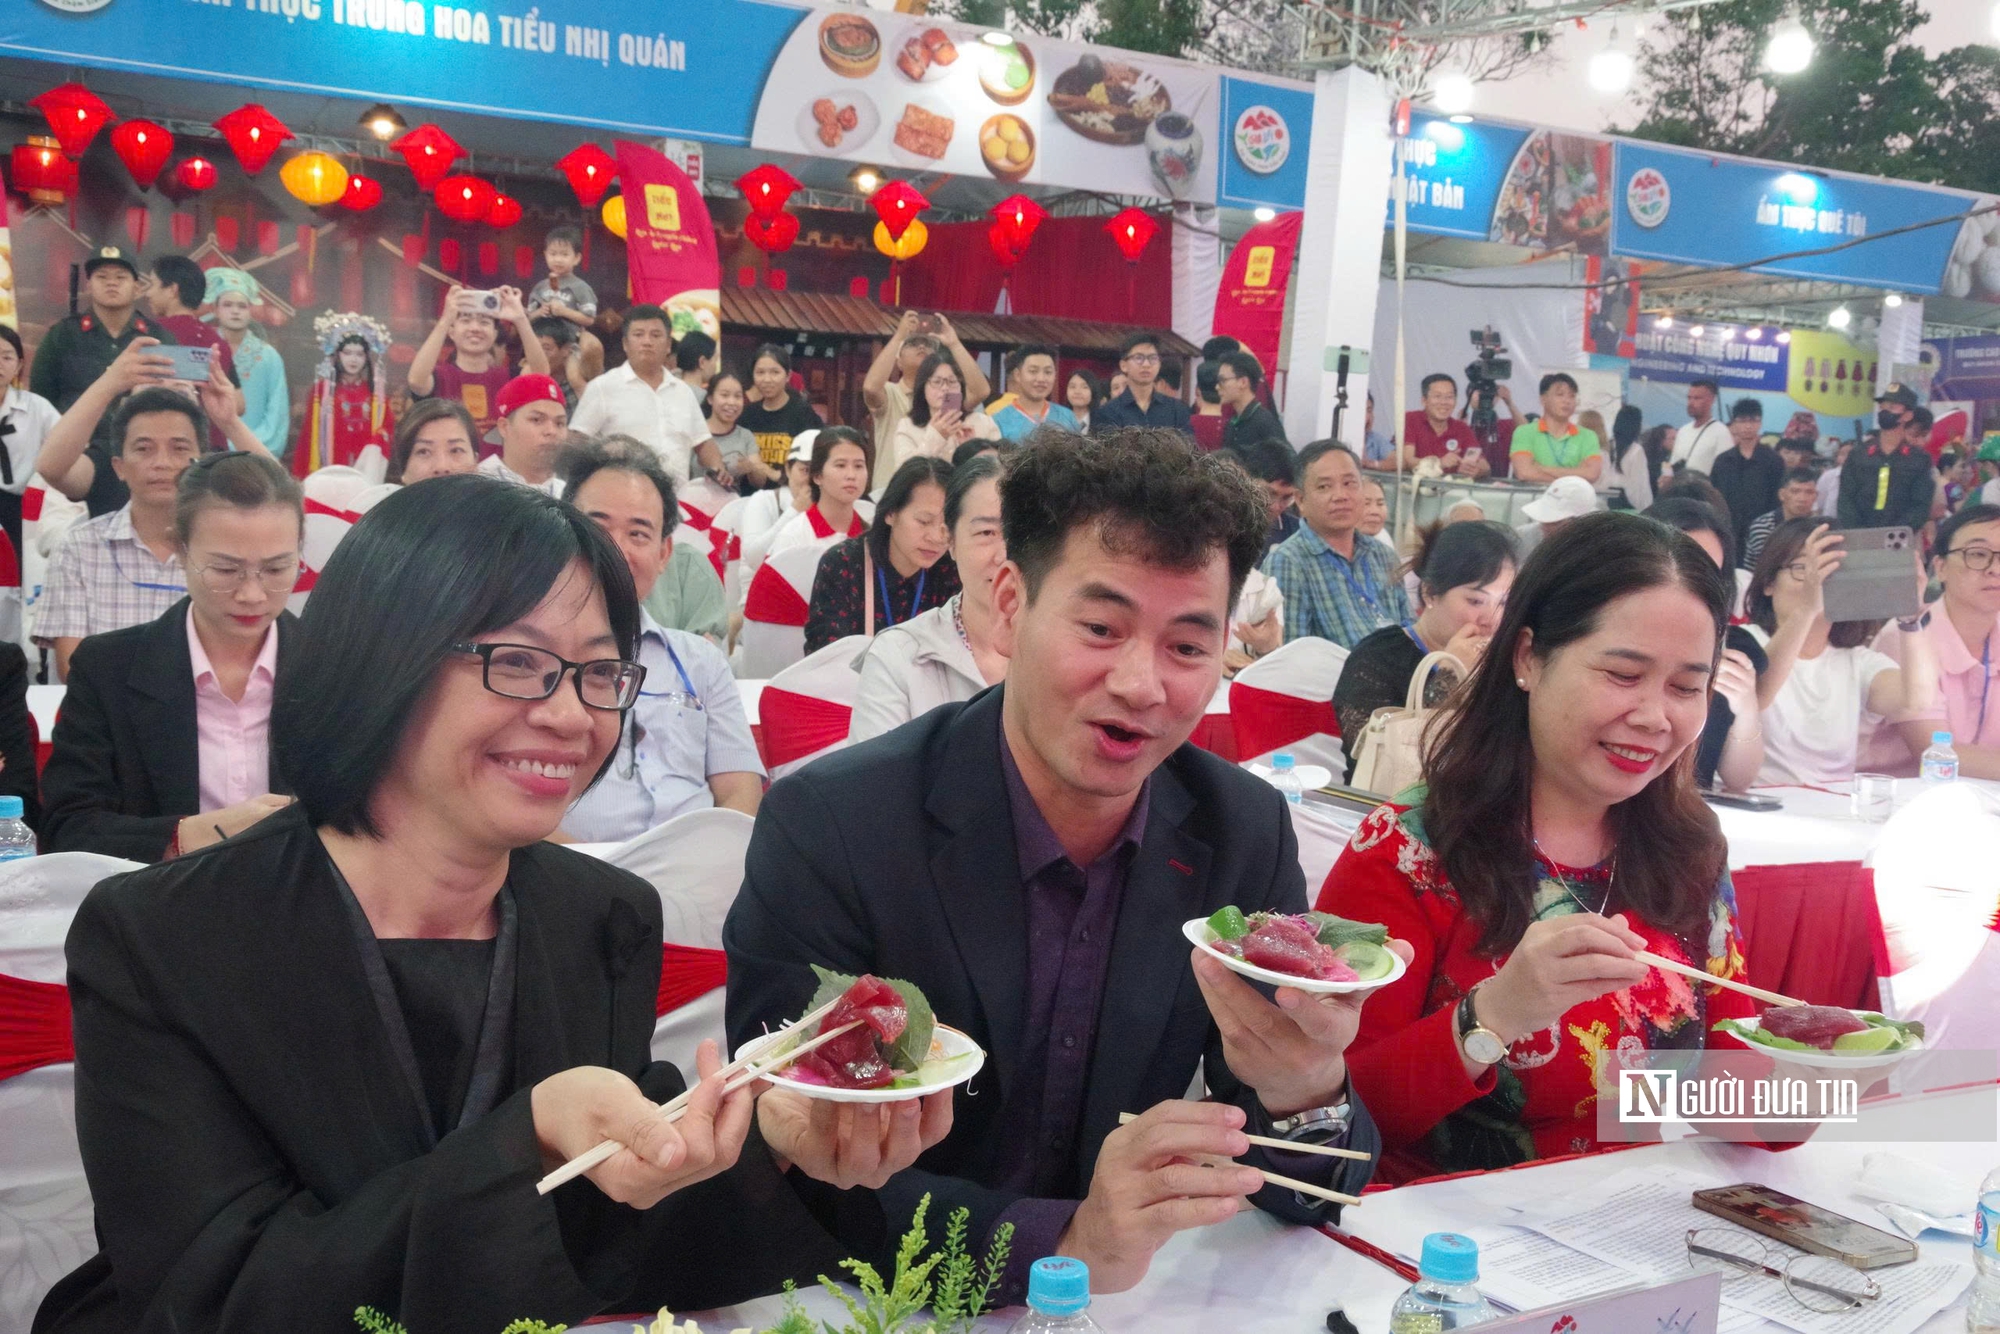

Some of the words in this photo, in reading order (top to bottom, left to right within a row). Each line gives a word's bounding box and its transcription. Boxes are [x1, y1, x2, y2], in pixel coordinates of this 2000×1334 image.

[333, 0, 425, 36] TRUNG
[434, 5, 490, 44] HOA
[498, 7, 555, 53] TIỂU
[564, 25, 609, 67] NHỊ
[618, 33, 686, 71] QUÁN
